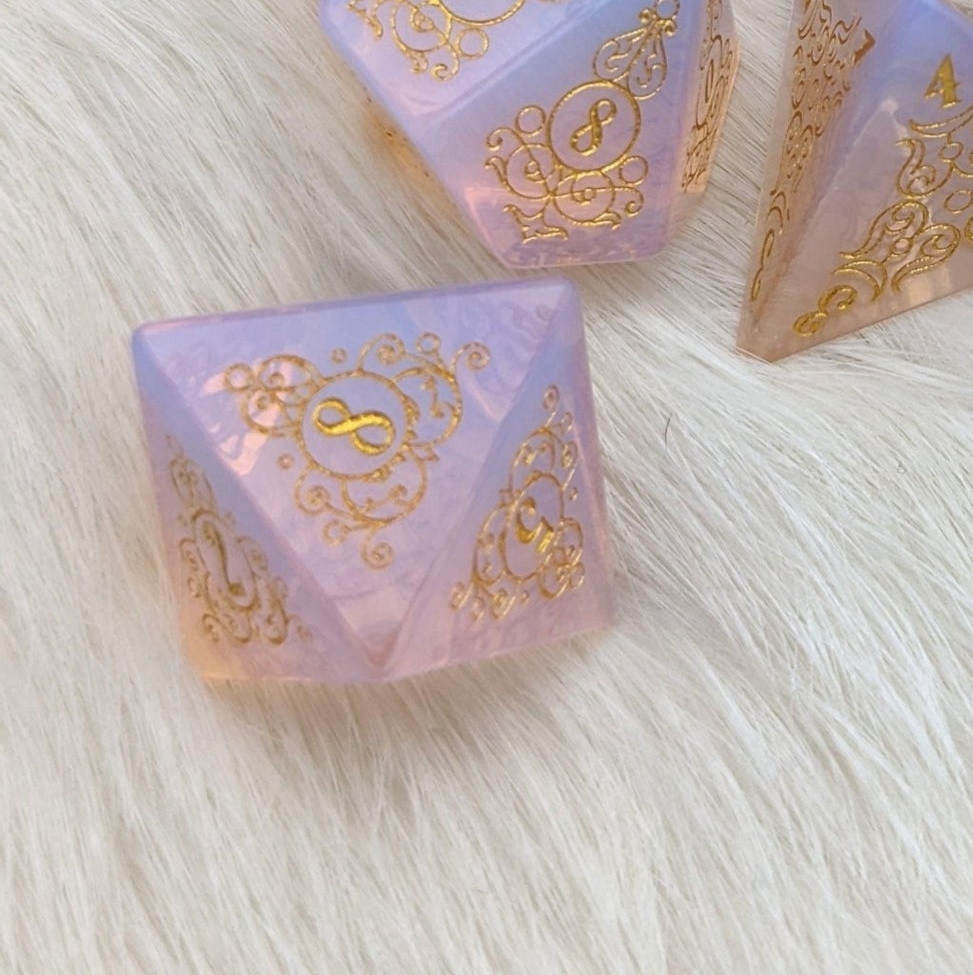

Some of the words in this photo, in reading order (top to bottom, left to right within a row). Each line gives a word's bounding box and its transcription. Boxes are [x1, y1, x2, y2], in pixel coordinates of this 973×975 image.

[924, 52, 963, 109] 4
[570, 98, 618, 156] 8
[793, 285, 858, 337] 3
[311, 397, 397, 457] 8
